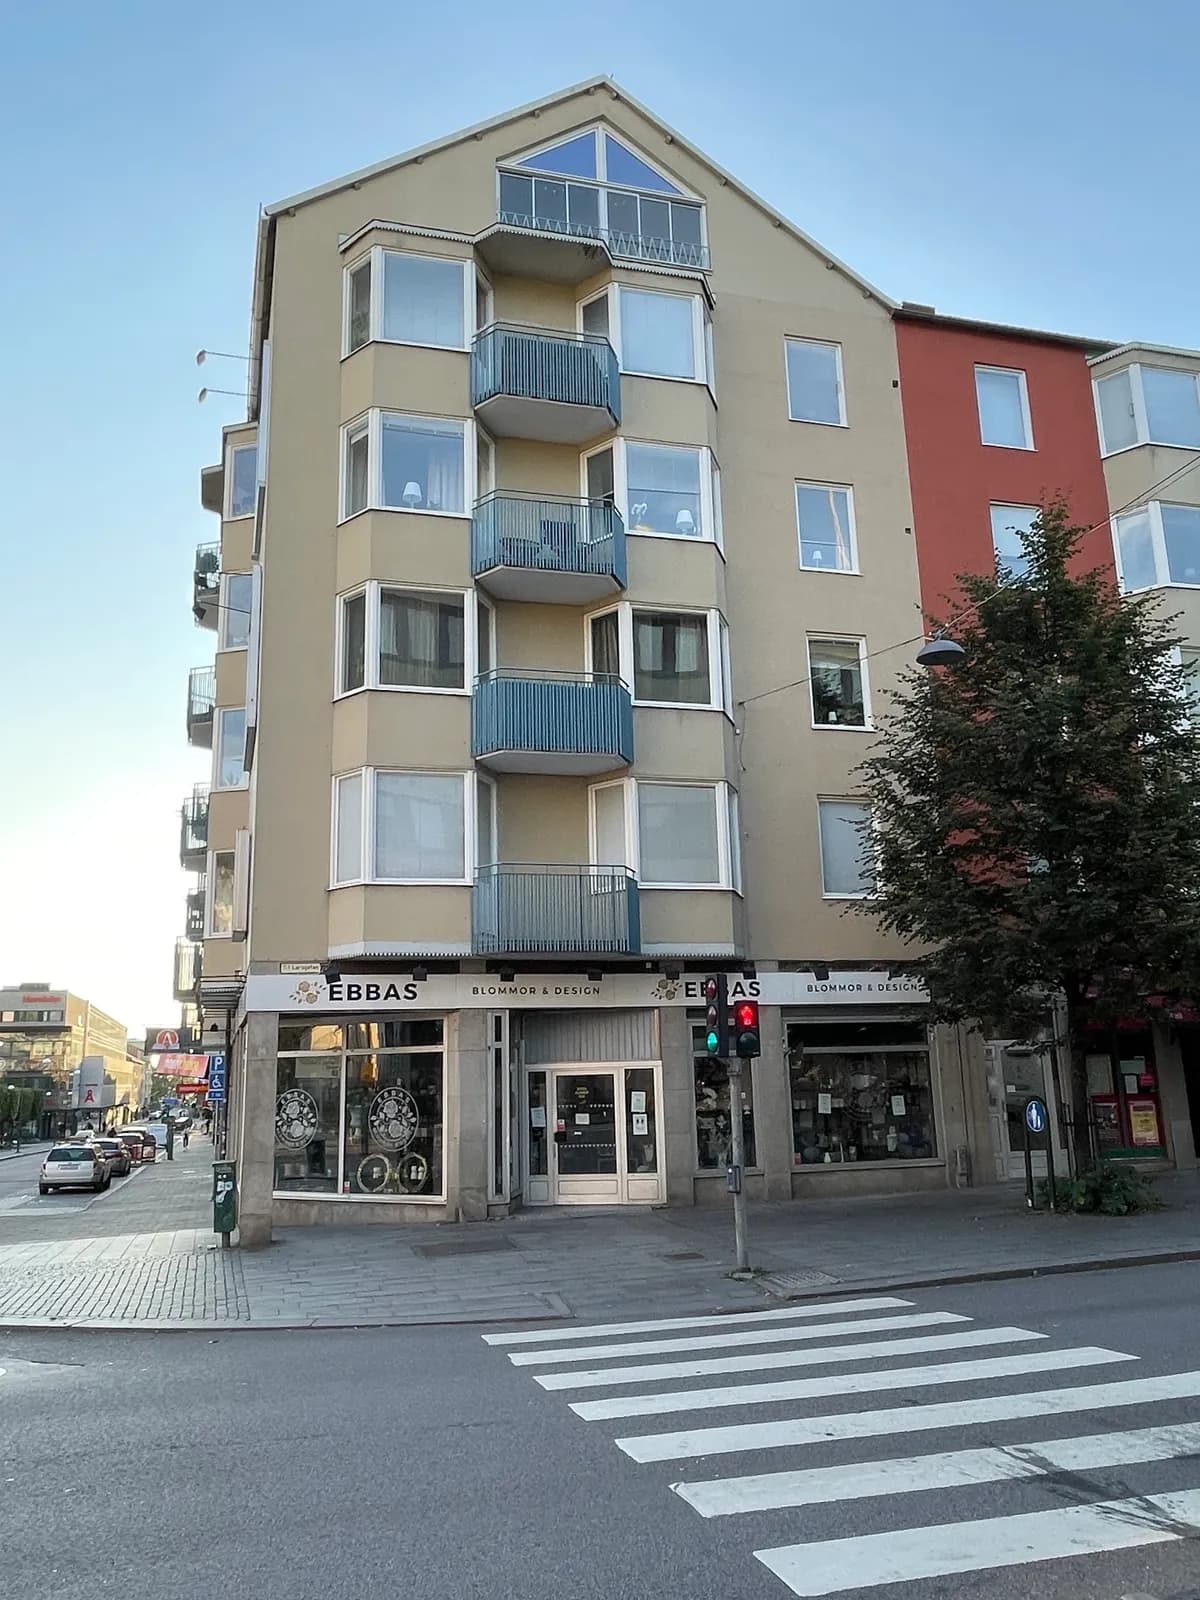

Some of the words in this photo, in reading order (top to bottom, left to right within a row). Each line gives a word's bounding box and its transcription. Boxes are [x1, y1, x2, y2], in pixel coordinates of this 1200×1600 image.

[329, 983, 418, 1001] EBBAS
[472, 986, 537, 995] BLOMMOR
[542, 986, 549, 995] &
[554, 986, 600, 995] DESIGN
[806, 982, 862, 993] BLOMMOR
[867, 983, 874, 992] &
[877, 982, 918, 992] DESIGN
[214, 1056, 223, 1071] P
